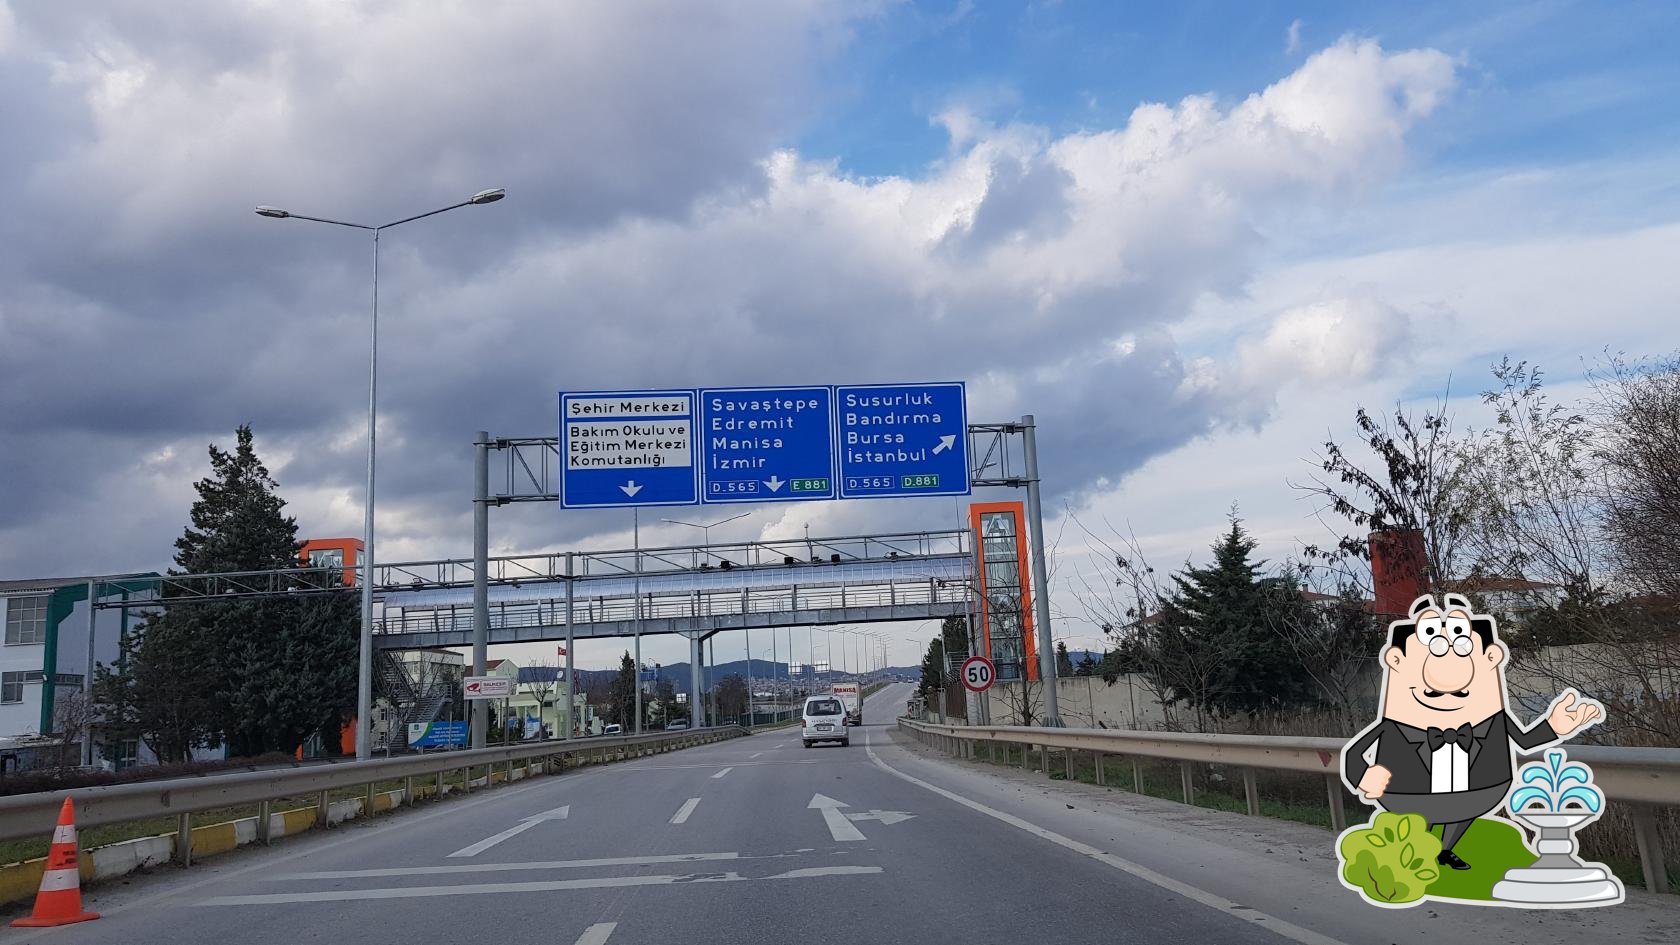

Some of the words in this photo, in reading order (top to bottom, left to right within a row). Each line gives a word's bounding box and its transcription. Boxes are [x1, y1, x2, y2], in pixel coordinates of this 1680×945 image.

[712, 398, 818, 412] Savaştepe
[846, 392, 933, 407] Susurluk
[572, 403, 614, 415] Şehir
[620, 402, 684, 413] Merkezi
[712, 417, 793, 430] Edremit
[846, 411, 941, 426] Bandırma
[571, 426, 619, 437] Bakım
[623, 425, 664, 436] Okulu
[669, 426, 685, 435] ve
[712, 437, 783, 450] Manisa
[847, 432, 905, 444] Bursa
[571, 441, 620, 454] Eğitim
[625, 439, 686, 450] Merkezi
[571, 454, 665, 467] Komutanlığı
[713, 454, 766, 469] İzmir
[848, 448, 926, 463] İstanbul
[793, 481, 800, 490] E
[804, 480, 826, 489] 881
[969, 666, 989, 683] 50
